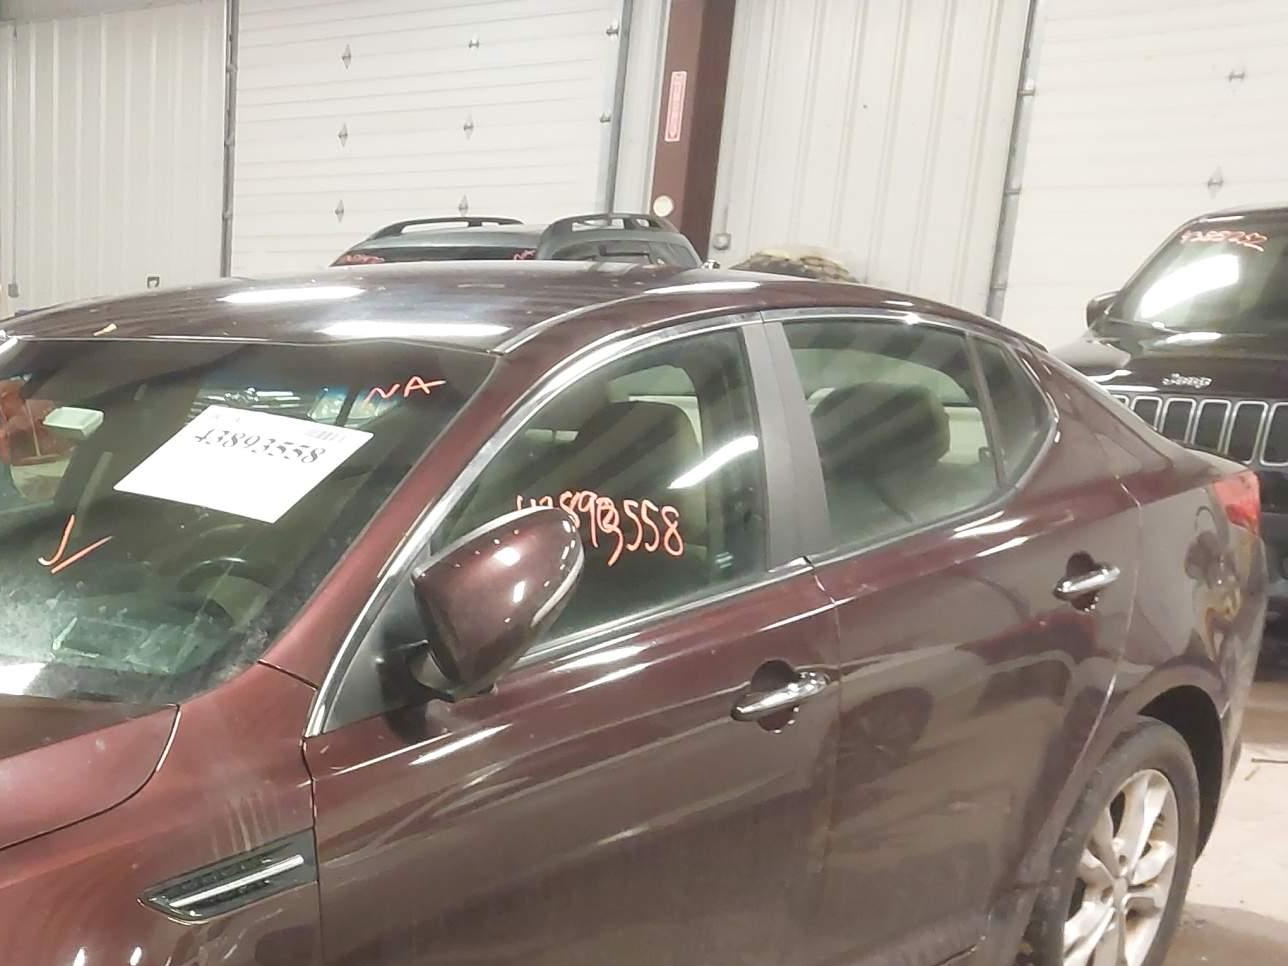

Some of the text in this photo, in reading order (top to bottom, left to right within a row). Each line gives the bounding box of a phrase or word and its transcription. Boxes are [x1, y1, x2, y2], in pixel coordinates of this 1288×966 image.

[363, 375, 447, 405] NA
[1161, 372, 1212, 389] Jeep
[194, 428, 327, 464] 43893558
